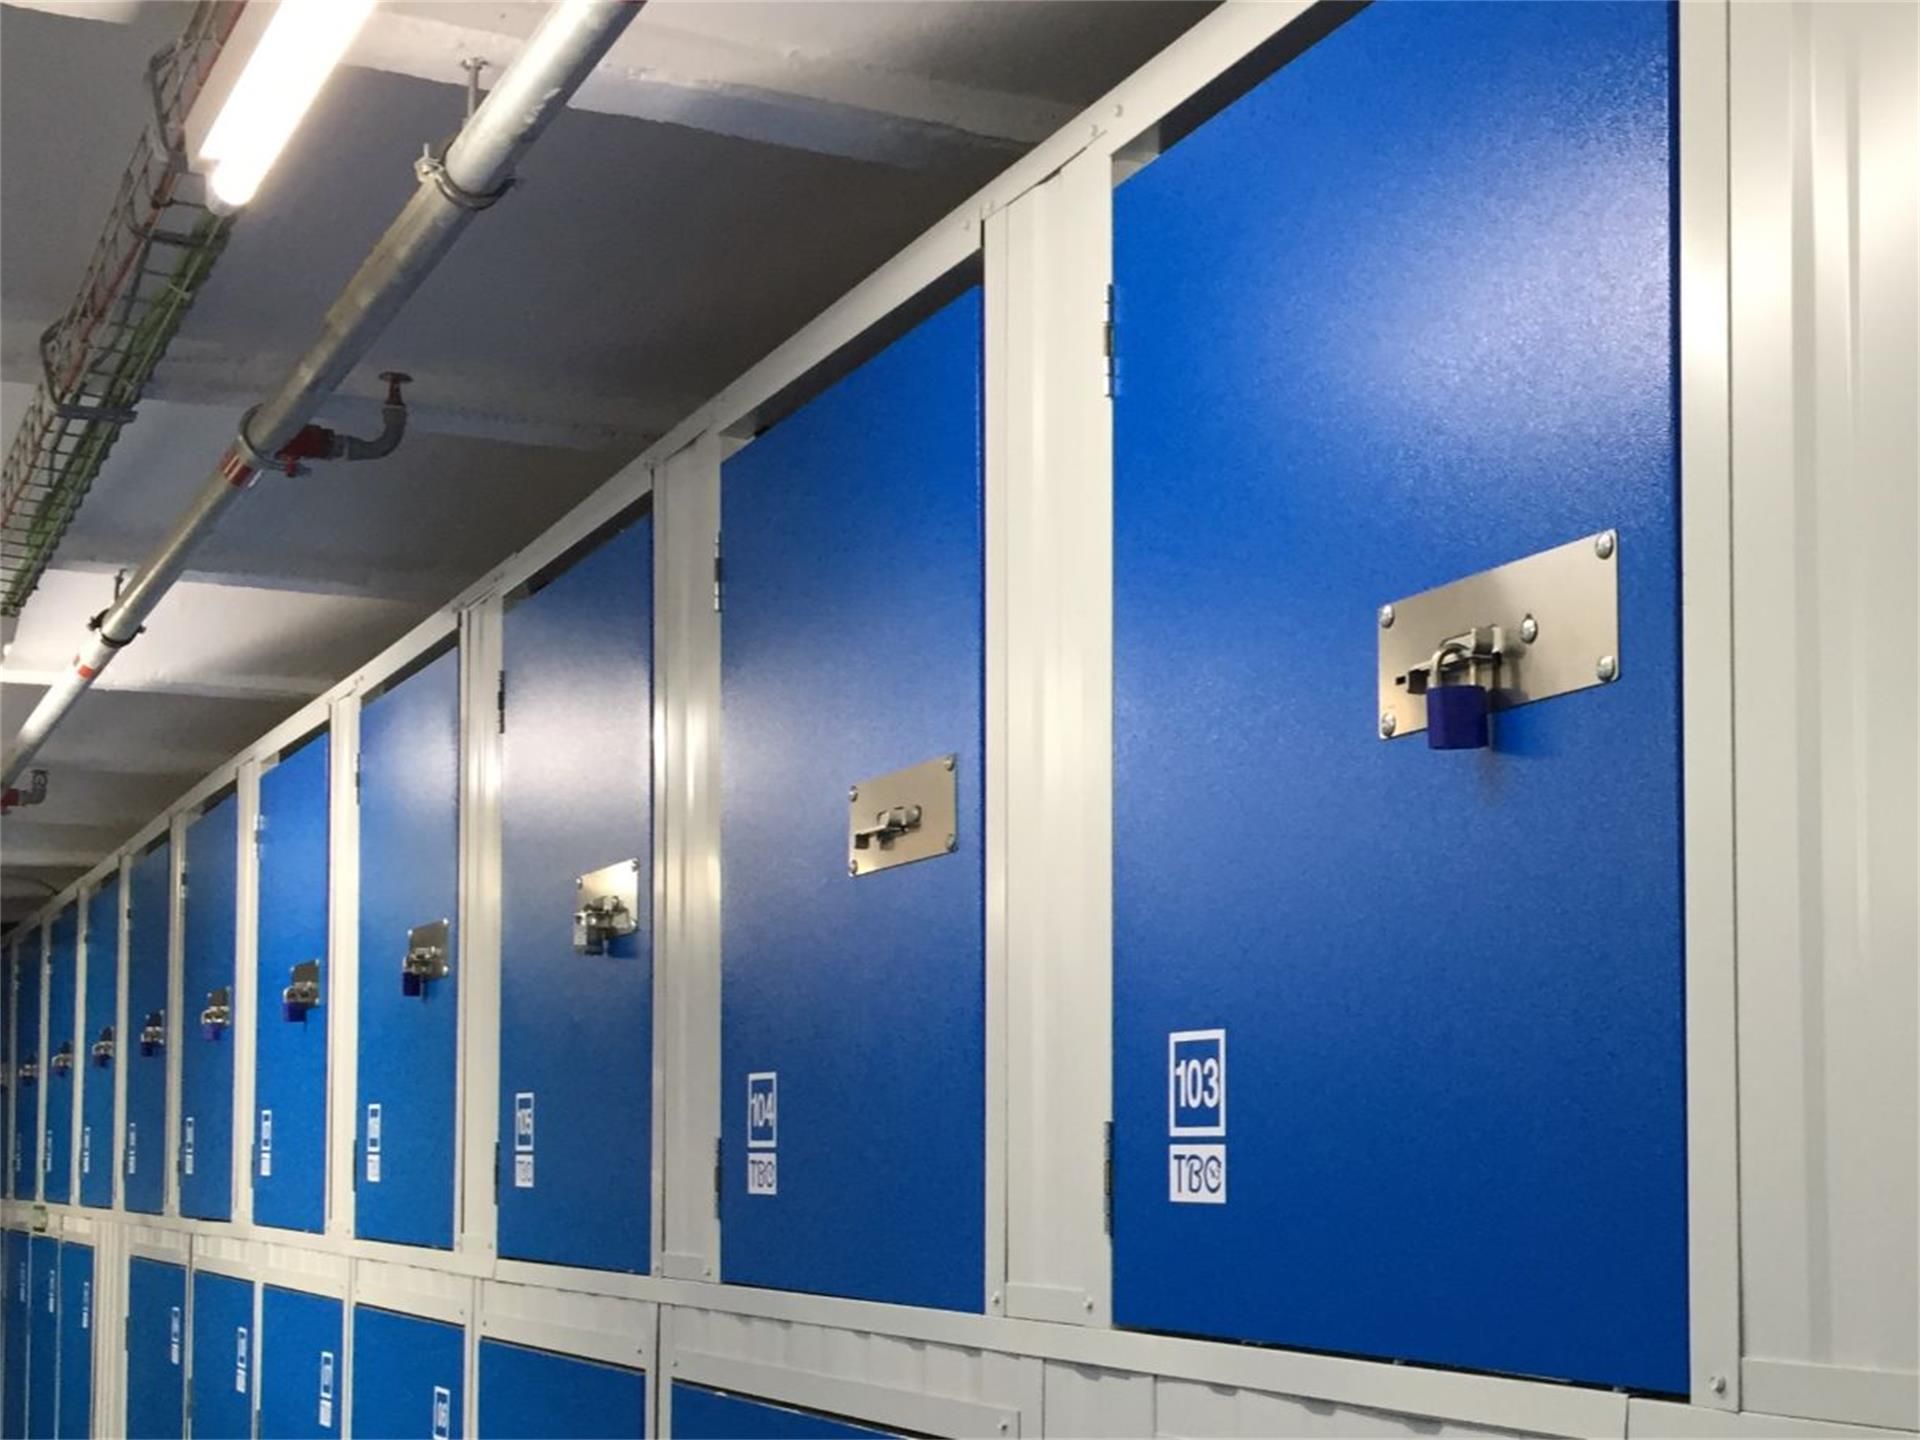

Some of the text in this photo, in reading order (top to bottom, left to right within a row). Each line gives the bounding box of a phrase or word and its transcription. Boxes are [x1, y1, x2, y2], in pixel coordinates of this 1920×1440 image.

[1175, 1058, 1220, 1109] 103
[751, 1092, 774, 1128] 104
[1173, 1154, 1222, 1194] TBC
